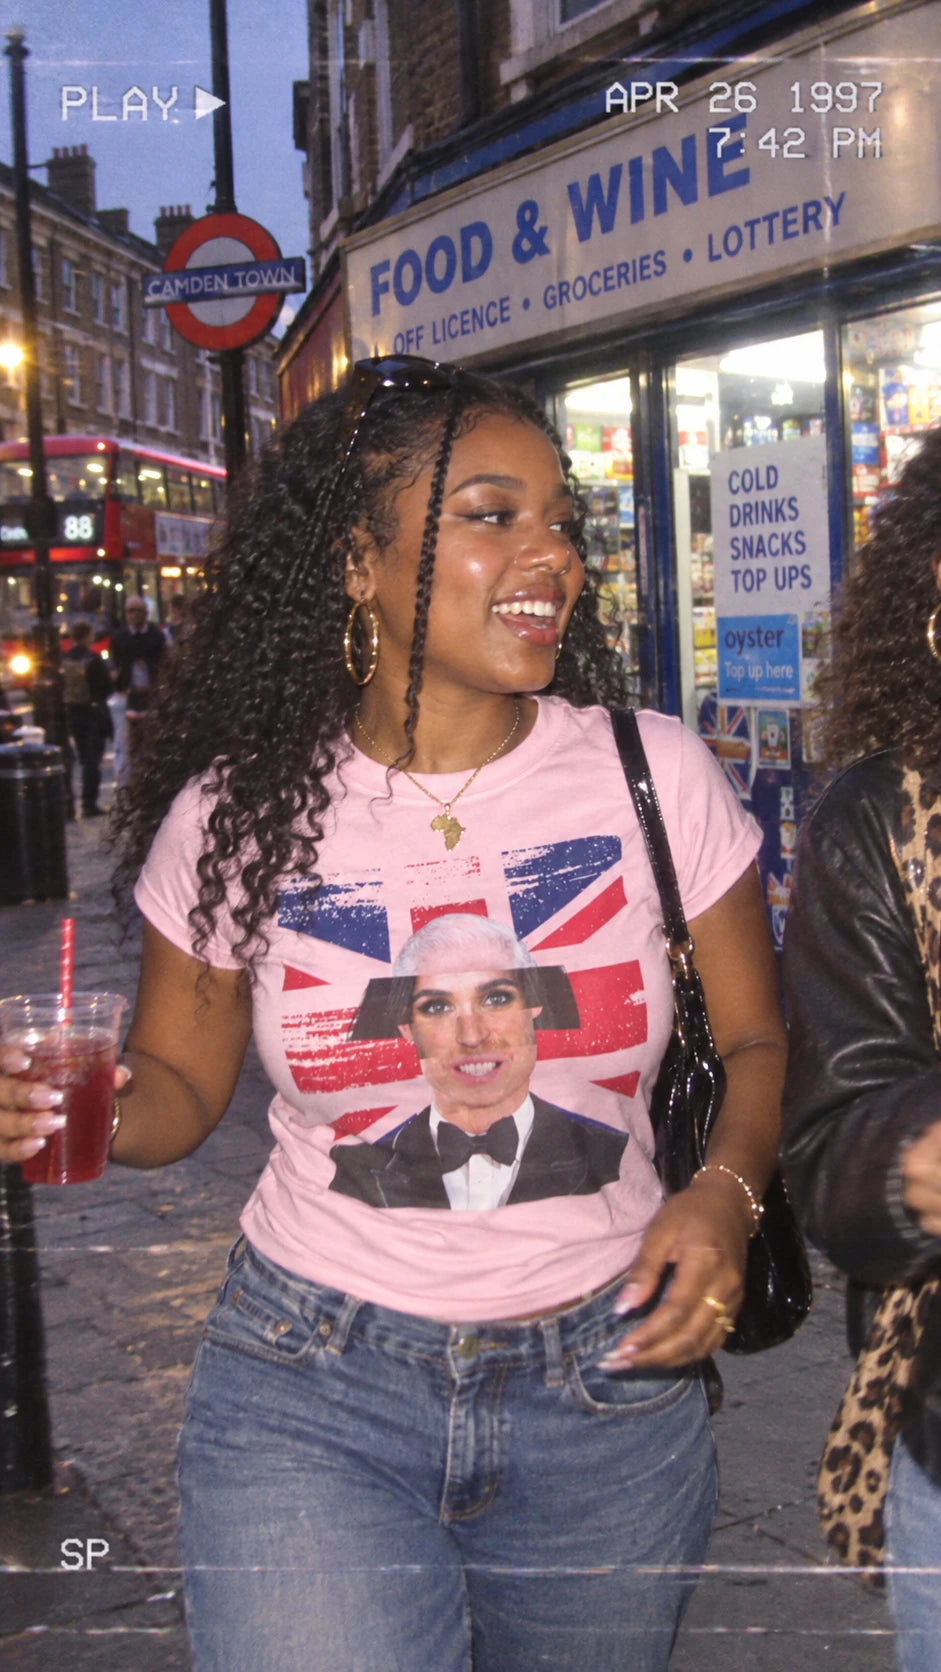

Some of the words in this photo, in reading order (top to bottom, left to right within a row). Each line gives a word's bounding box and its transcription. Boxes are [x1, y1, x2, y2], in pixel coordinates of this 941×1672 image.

[370, 220, 494, 317] FOOD
[512, 199, 551, 264] &
[567, 112, 751, 242] WINE
[147, 273, 229, 298] CAMDEN
[235, 265, 296, 288] TOWN
[393, 325, 425, 355] OFF
[432, 296, 511, 345] LICENCE
[543, 249, 668, 311] GROCERIES
[708, 191, 847, 262] LOTTERY
[728, 465, 779, 495] COLD
[64, 515, 94, 540] 88
[729, 497, 800, 528] DRINKS
[730, 530, 807, 561] SNACKS
[731, 568, 767, 593] TOP
[774, 564, 812, 590] UPS
[724, 626, 785, 656] oyster
[724, 660, 746, 682] Top
[747, 663, 764, 682] up
[765, 661, 794, 679] here
